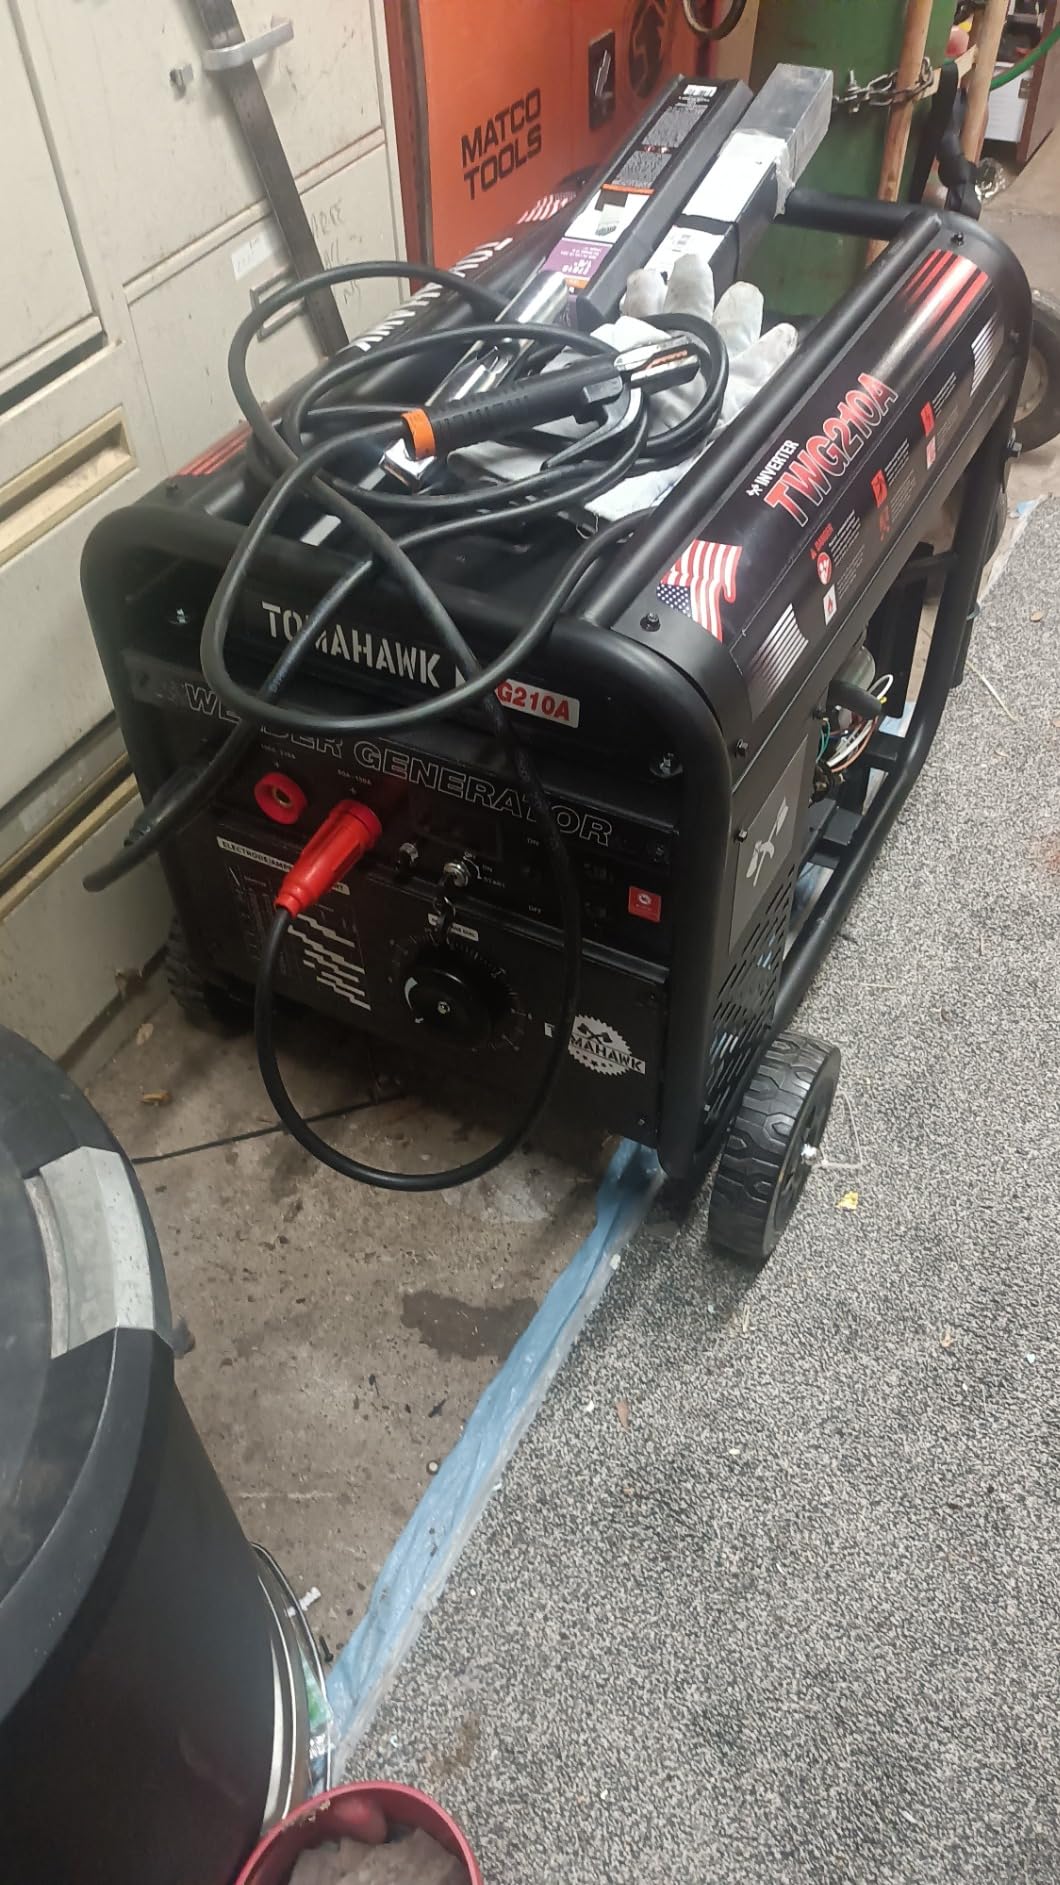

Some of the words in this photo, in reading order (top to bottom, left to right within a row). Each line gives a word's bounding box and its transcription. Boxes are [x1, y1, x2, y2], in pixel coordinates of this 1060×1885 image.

[461, 88, 541, 168] MATCO
[464, 123, 542, 200] TOOLS
[754, 440, 799, 487] INVERTER
[764, 372, 899, 527] TWG210A
[497, 681, 570, 721] G210A
[354, 741, 612, 846] GENERAOR
[568, 1033, 642, 1071] MAHAWK
